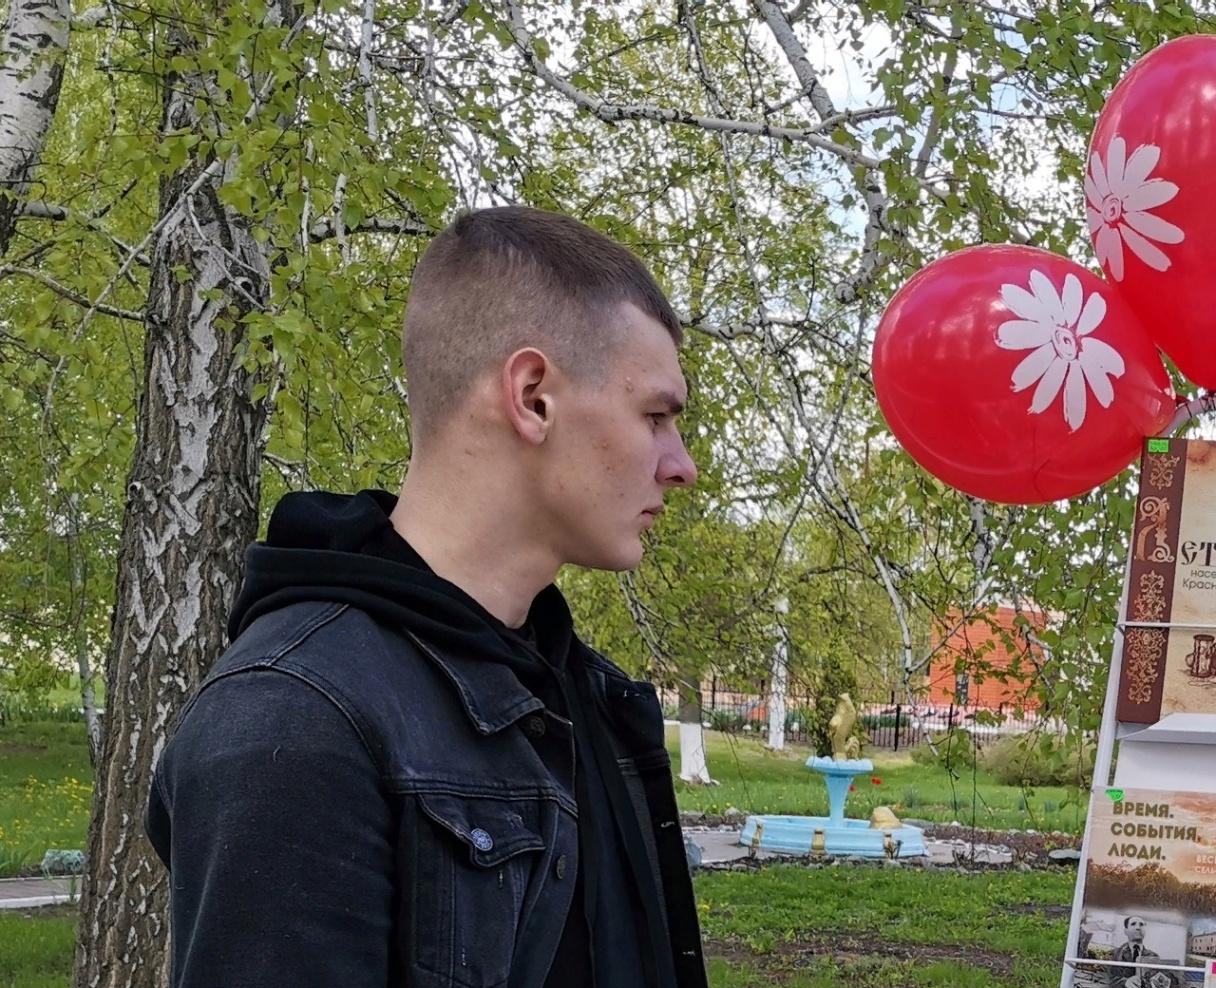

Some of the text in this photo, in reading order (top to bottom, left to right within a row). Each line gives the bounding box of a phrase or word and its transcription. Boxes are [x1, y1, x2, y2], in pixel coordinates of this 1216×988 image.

[1112, 800, 1174, 819] ВРЕМЯ.
[1110, 823, 1202, 843] СОБЫТИЯ.
[1107, 843, 1167, 861] ЛЮДИ.
